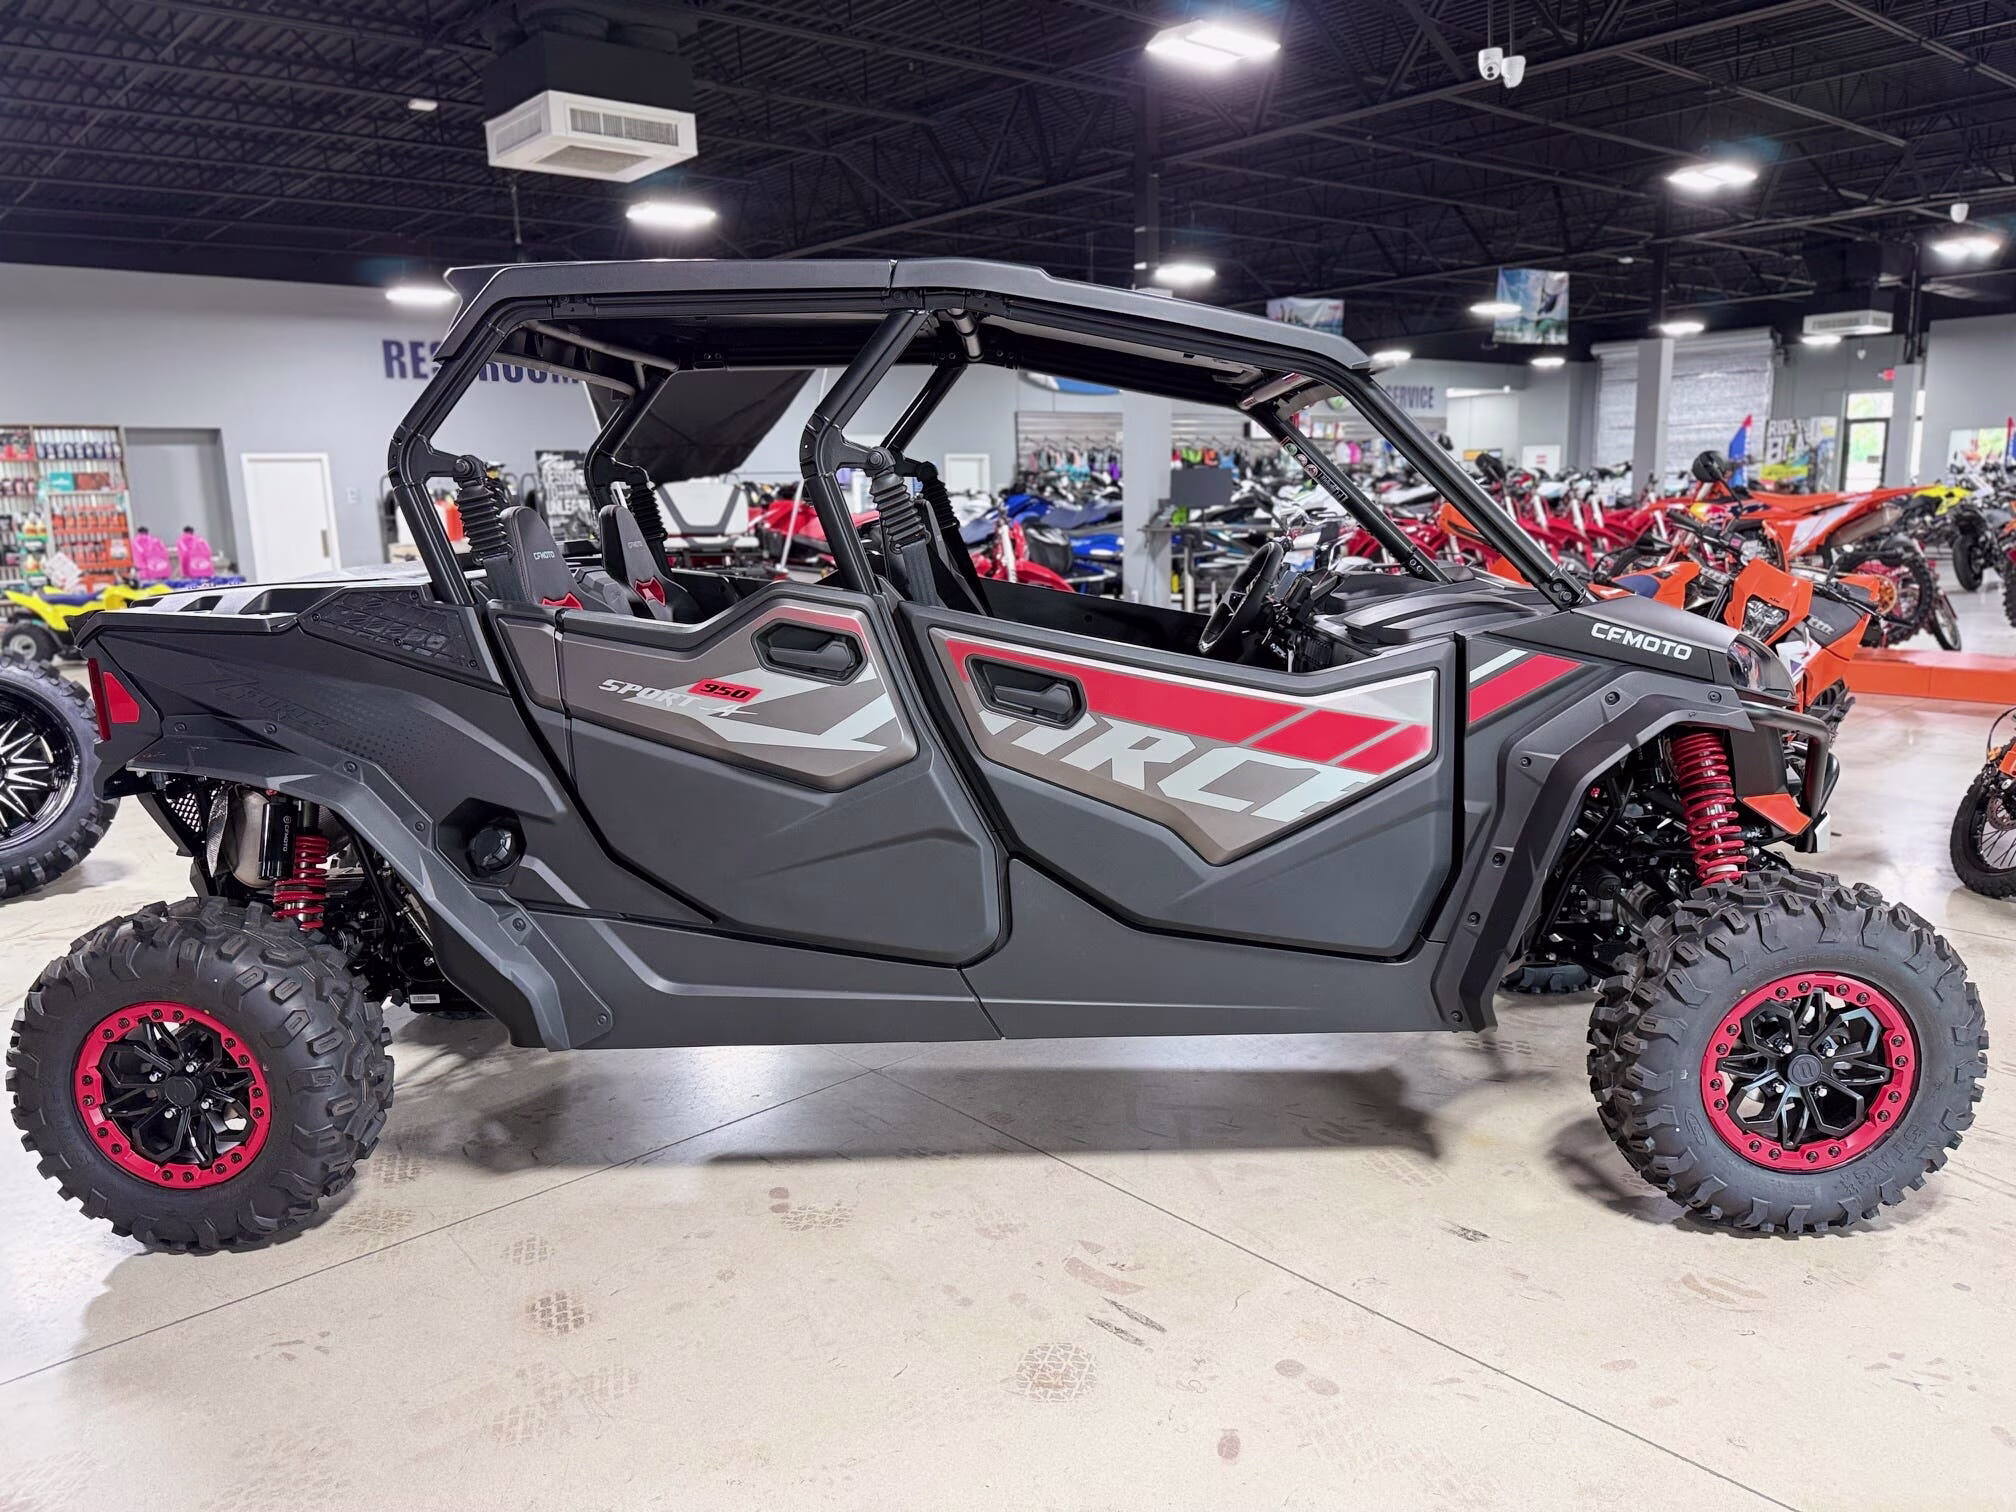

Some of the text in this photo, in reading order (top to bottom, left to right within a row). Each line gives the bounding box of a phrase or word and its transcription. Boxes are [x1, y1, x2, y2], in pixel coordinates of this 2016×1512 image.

[1590, 622, 1693, 661] CFMOTO
[598, 679, 700, 708] SPORT
[700, 683, 751, 699] 950
